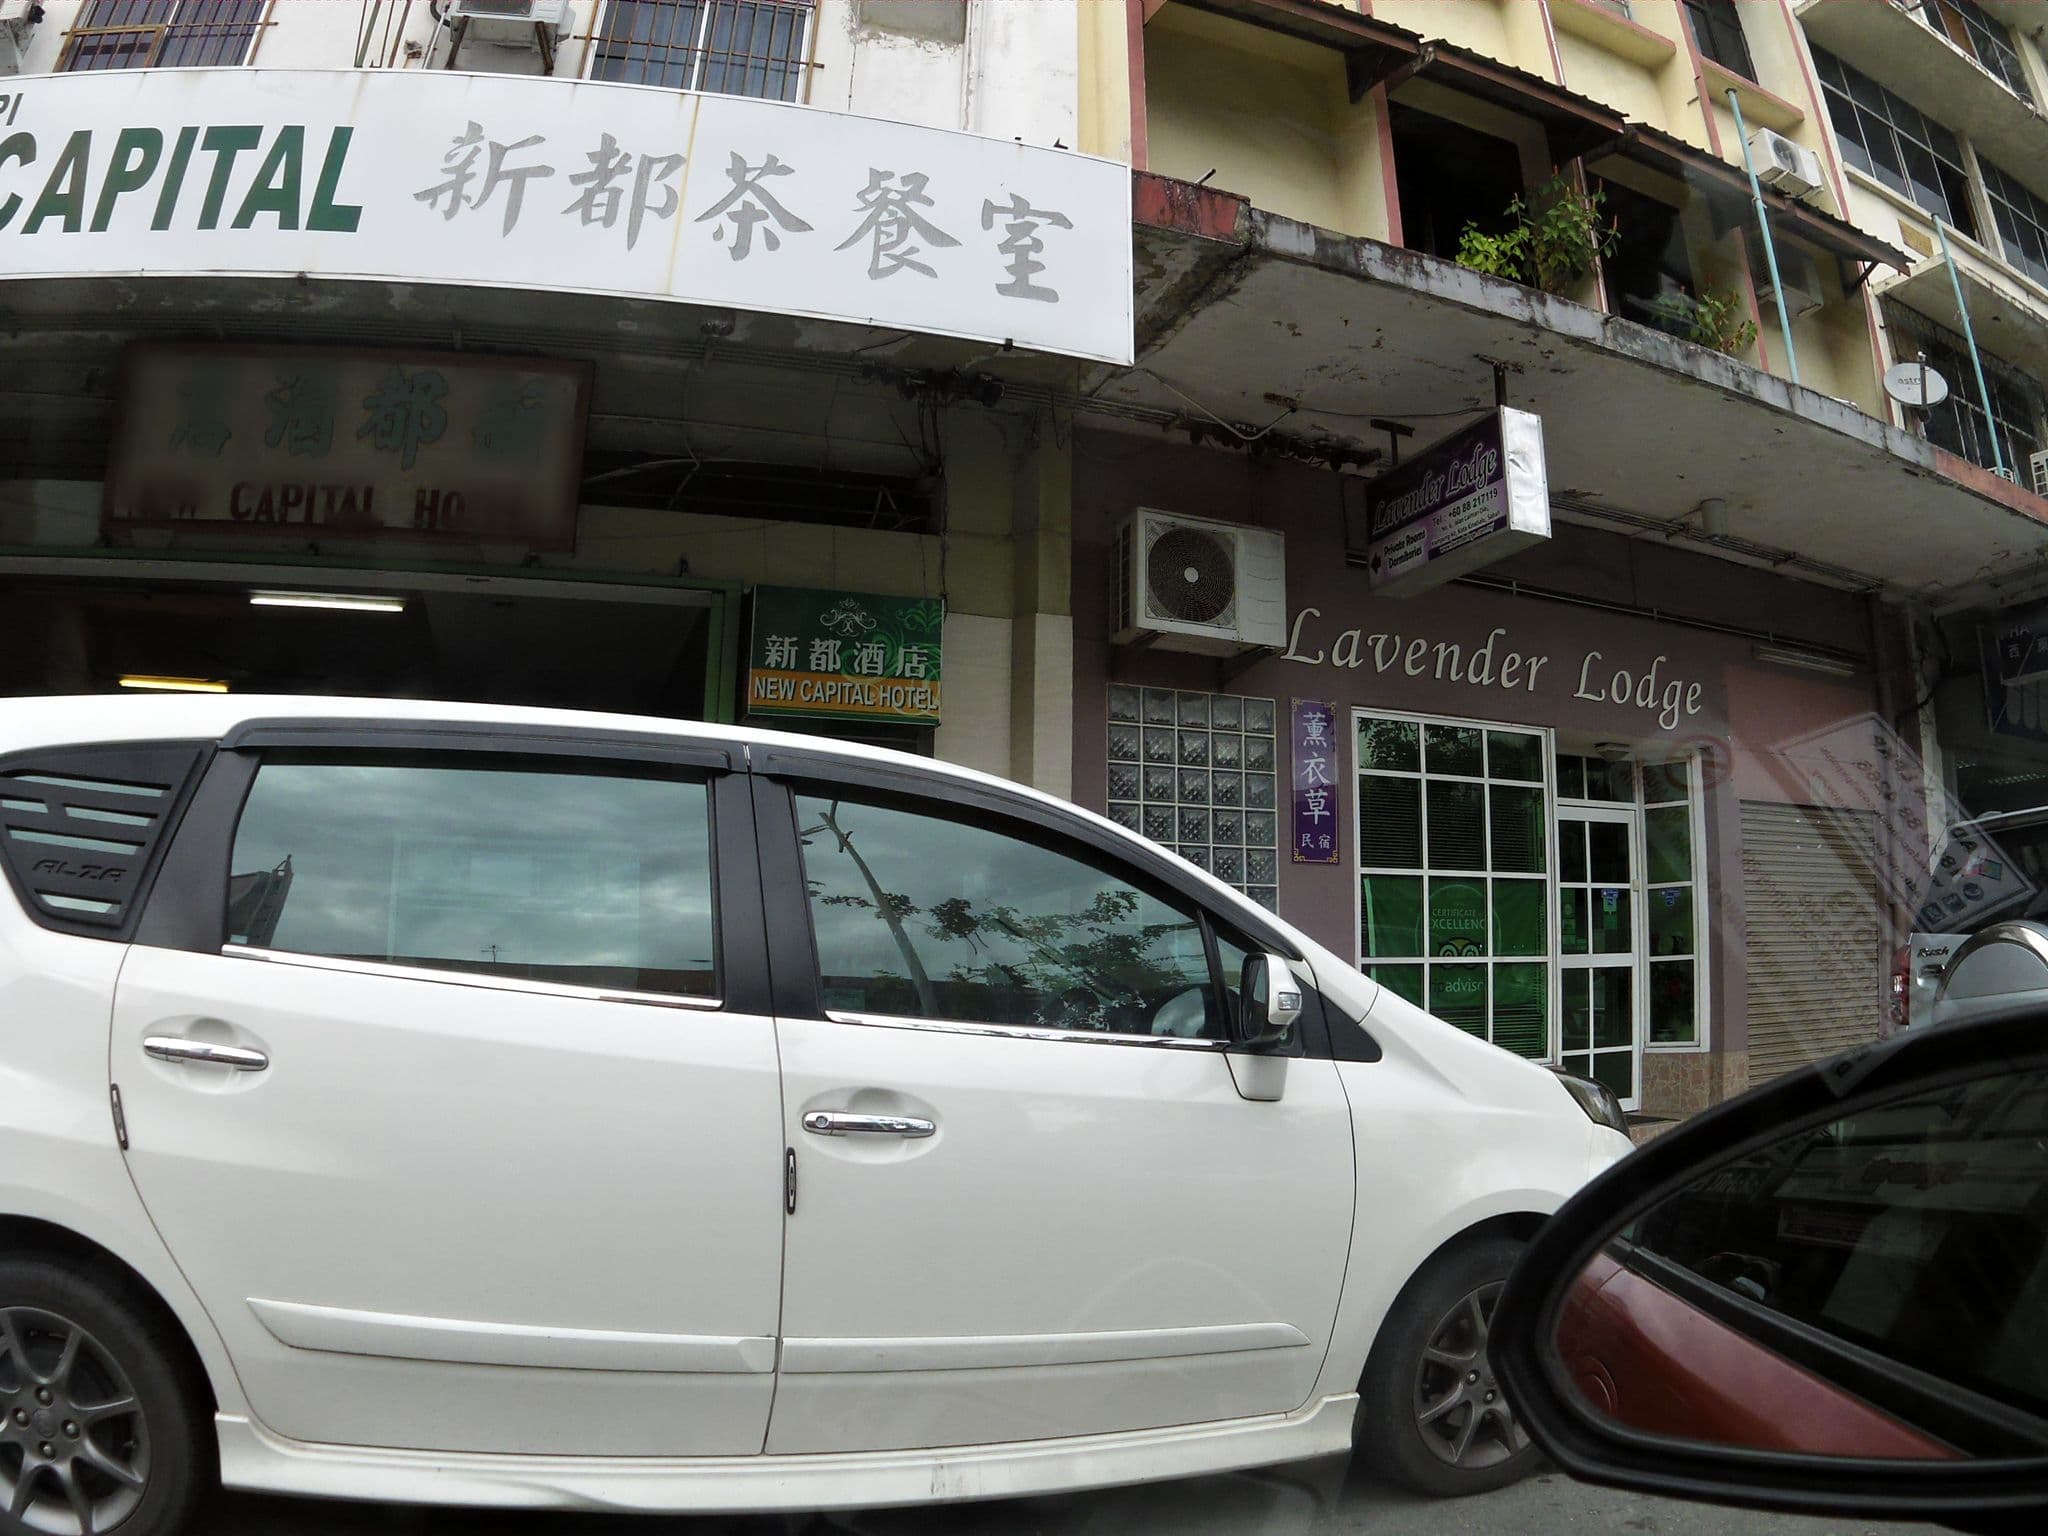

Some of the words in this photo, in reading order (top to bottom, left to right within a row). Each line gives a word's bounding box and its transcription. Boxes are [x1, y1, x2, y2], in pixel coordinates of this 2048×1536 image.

[0, 126, 363, 236] CAPITAL
[412, 119, 1074, 304] 新都茶餐室
[1372, 470, 1446, 535] Lavender
[1445, 443, 1498, 497] Lodge
[754, 676, 796, 701] NEW
[800, 679, 875, 706] CAPITAL
[879, 685, 939, 711] HOTEL
[764, 634, 929, 679] 新都酒店
[1280, 607, 1548, 692] Lavender
[1573, 651, 1703, 730] Lodge
[1301, 711, 1332, 826] 薰衣草
[1301, 833, 1331, 850] 民宿
